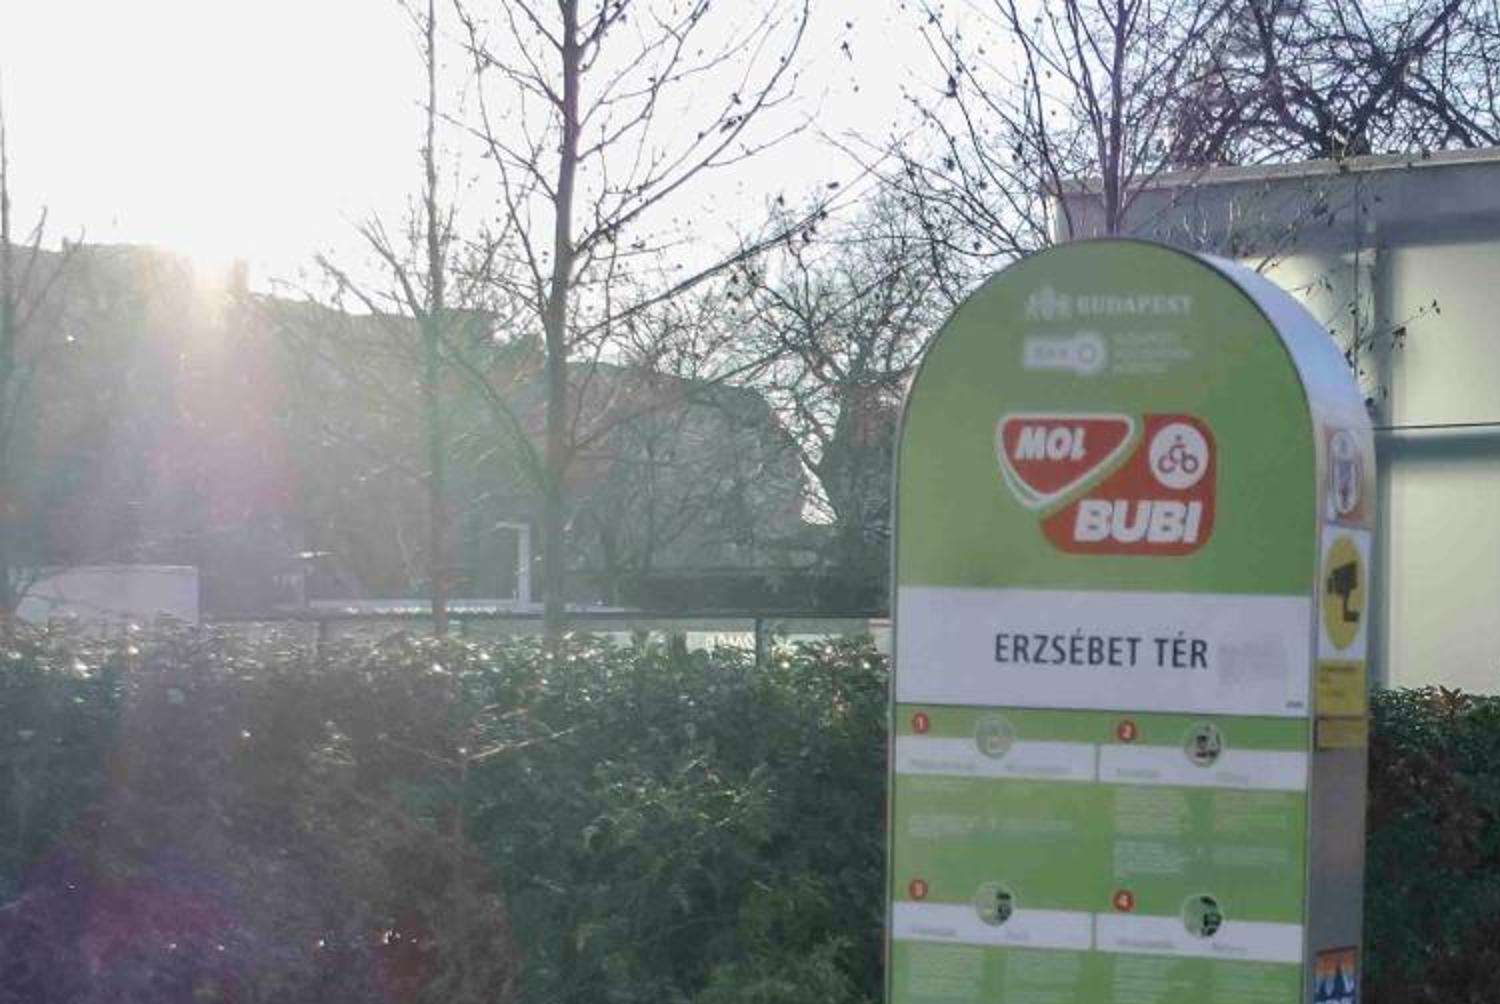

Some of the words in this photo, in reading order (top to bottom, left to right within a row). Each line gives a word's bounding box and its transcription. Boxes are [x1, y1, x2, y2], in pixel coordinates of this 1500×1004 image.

[1014, 425, 1087, 461] MOL
[1073, 499, 1202, 543] BUBI
[994, 627, 1142, 667] ERZSÉBET
[1153, 631, 1208, 668] TÉR
